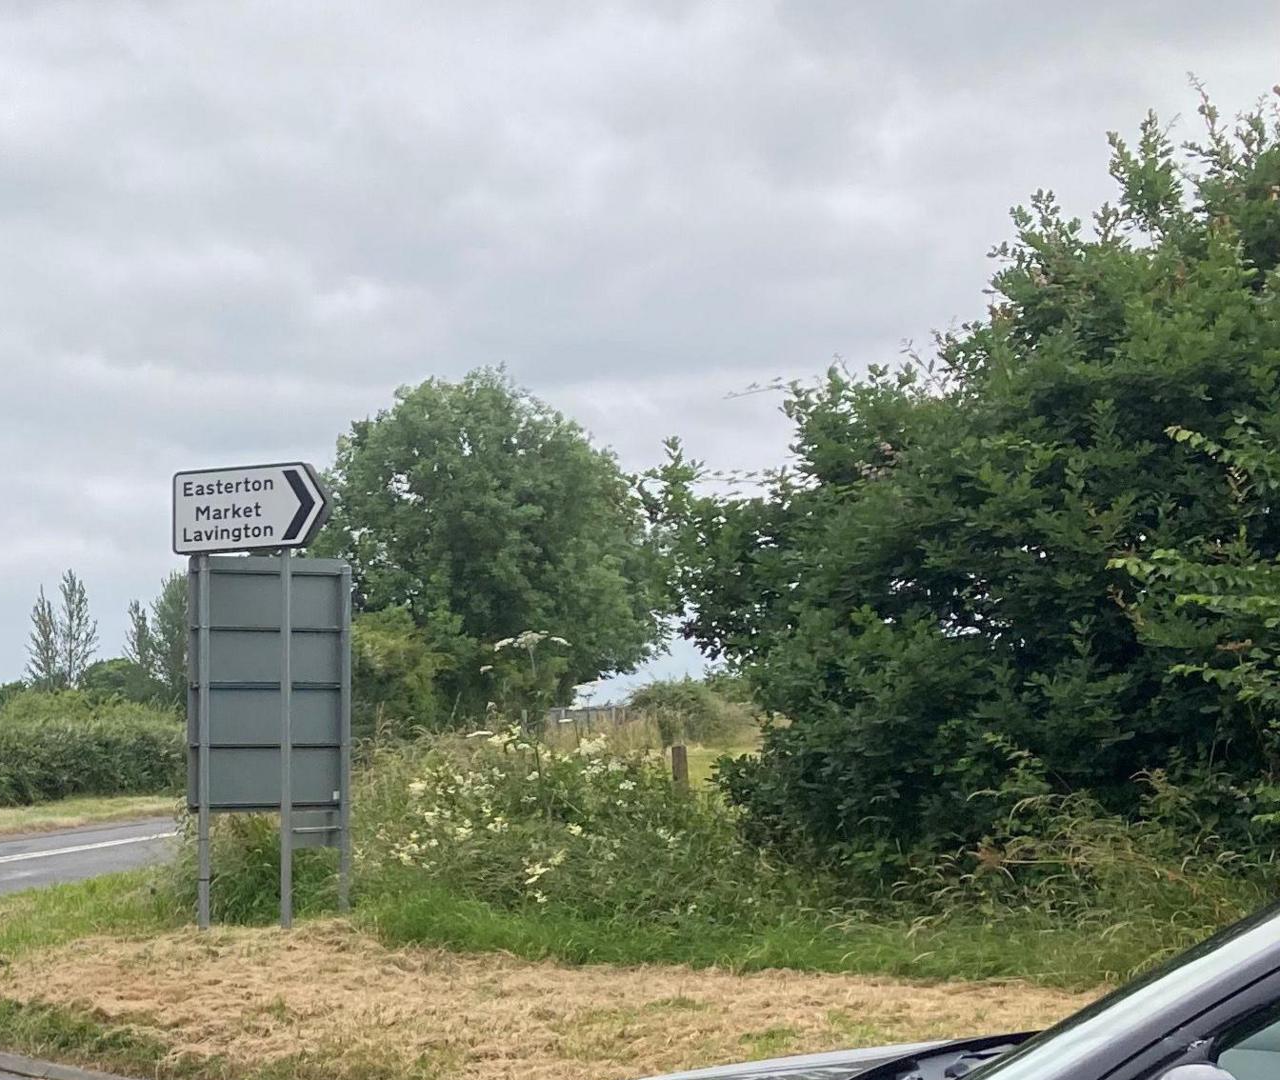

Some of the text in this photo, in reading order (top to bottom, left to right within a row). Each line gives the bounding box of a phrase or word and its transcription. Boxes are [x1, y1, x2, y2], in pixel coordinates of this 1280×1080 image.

[183, 478, 274, 497] Easterton
[195, 502, 262, 521] Market
[183, 524, 274, 543] Lavington
